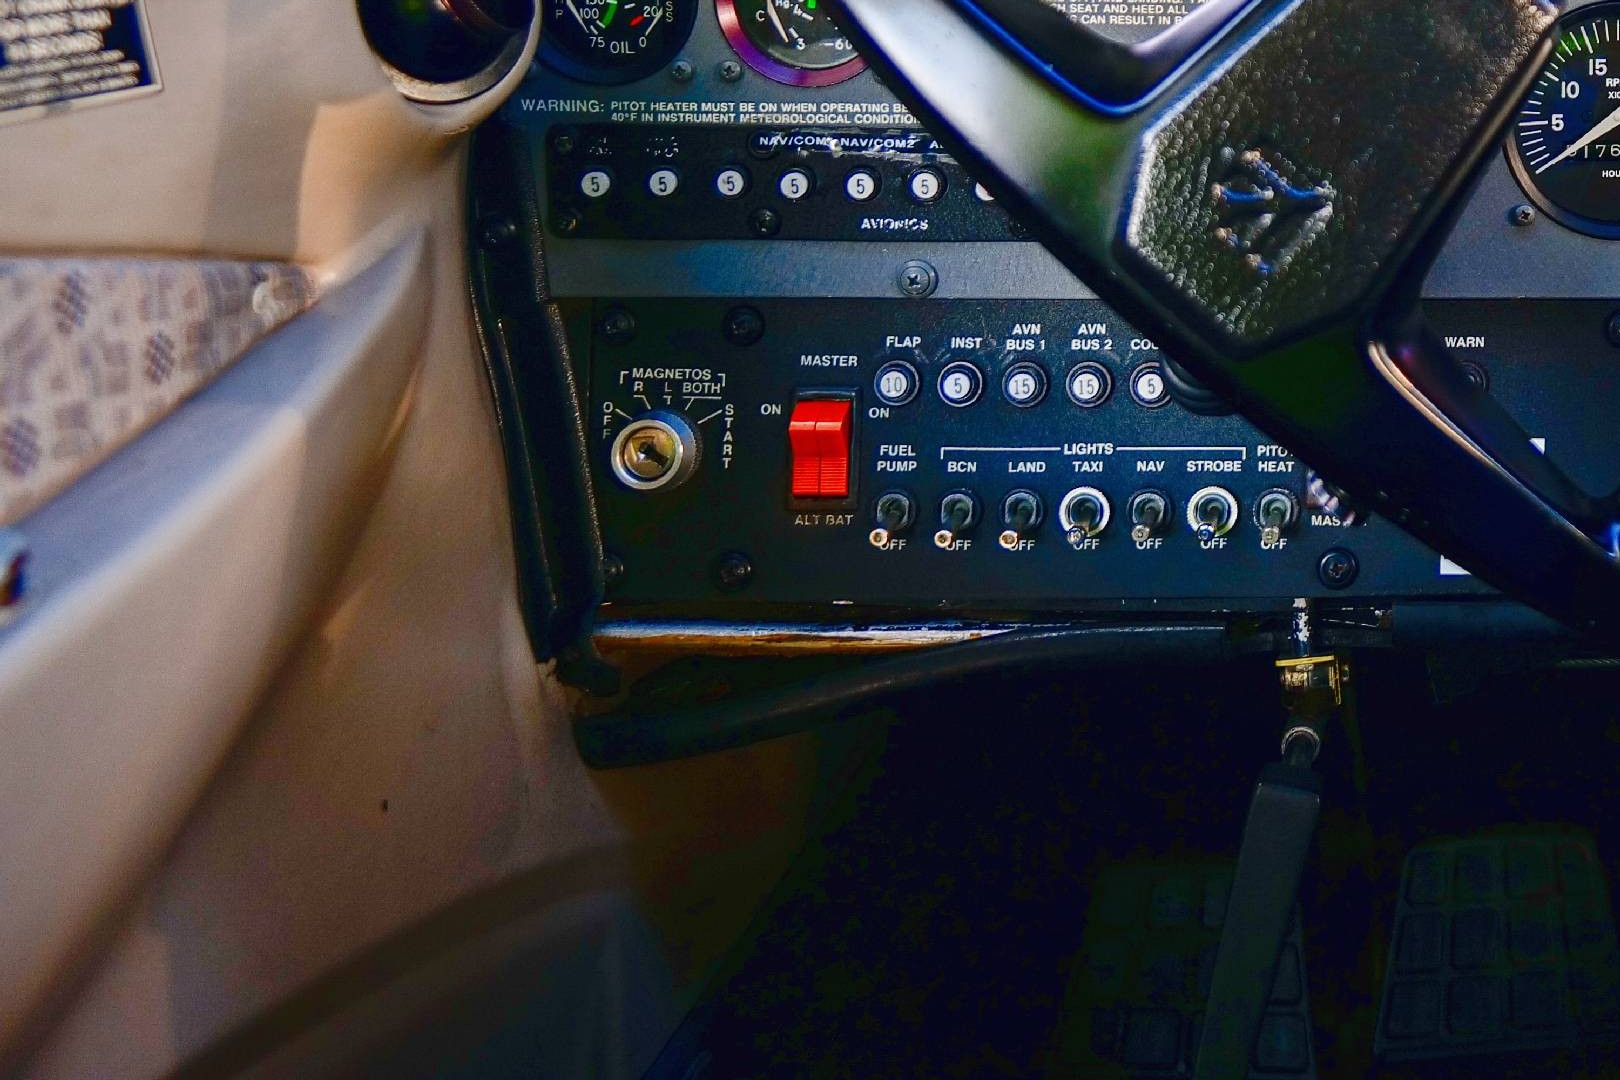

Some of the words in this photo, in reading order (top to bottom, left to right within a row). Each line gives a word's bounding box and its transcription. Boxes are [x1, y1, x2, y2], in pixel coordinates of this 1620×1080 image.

[610, 41, 635, 54] OIL
[1589, 59, 1607, 75] 15
[521, 99, 604, 112] WARNING:
[611, 102, 647, 112] PITOT
[651, 102, 698, 112] HEATER
[702, 102, 735, 112] MUST
[739, 102, 755, 112] BE
[760, 103, 778, 112] ON
[781, 103, 817, 113] WHEN
[820, 103, 889, 113] OPERATING
[611, 113, 638, 121] 40°F
[641, 113, 654, 122] IN
[657, 113, 736, 122] INSTRUMENT
[740, 113, 849, 123] METEOROLOGICAL
[1012, 324, 1040, 334] AVN
[887, 336, 921, 347] FLAP
[951, 338, 982, 348] INST
[1007, 339, 1036, 350] BUS
[1041, 340, 1045, 350] 1
[1445, 337, 1484, 348] WARN
[801, 356, 858, 367] MASTER
[632, 368, 711, 380] MAGNETOS
[683, 382, 720, 393] BOTH
[761, 404, 781, 415] ON
[880, 445, 915, 456] FUEL
[1064, 444, 1113, 454] LIGHTS
[877, 461, 917, 471] PUMP
[948, 462, 977, 472] BCN
[1008, 462, 1046, 472] LAND
[1073, 461, 1103, 472] TAXI
[1136, 461, 1164, 471] NAV
[1187, 461, 1242, 472] STROBE
[1258, 461, 1294, 472] HEAT
